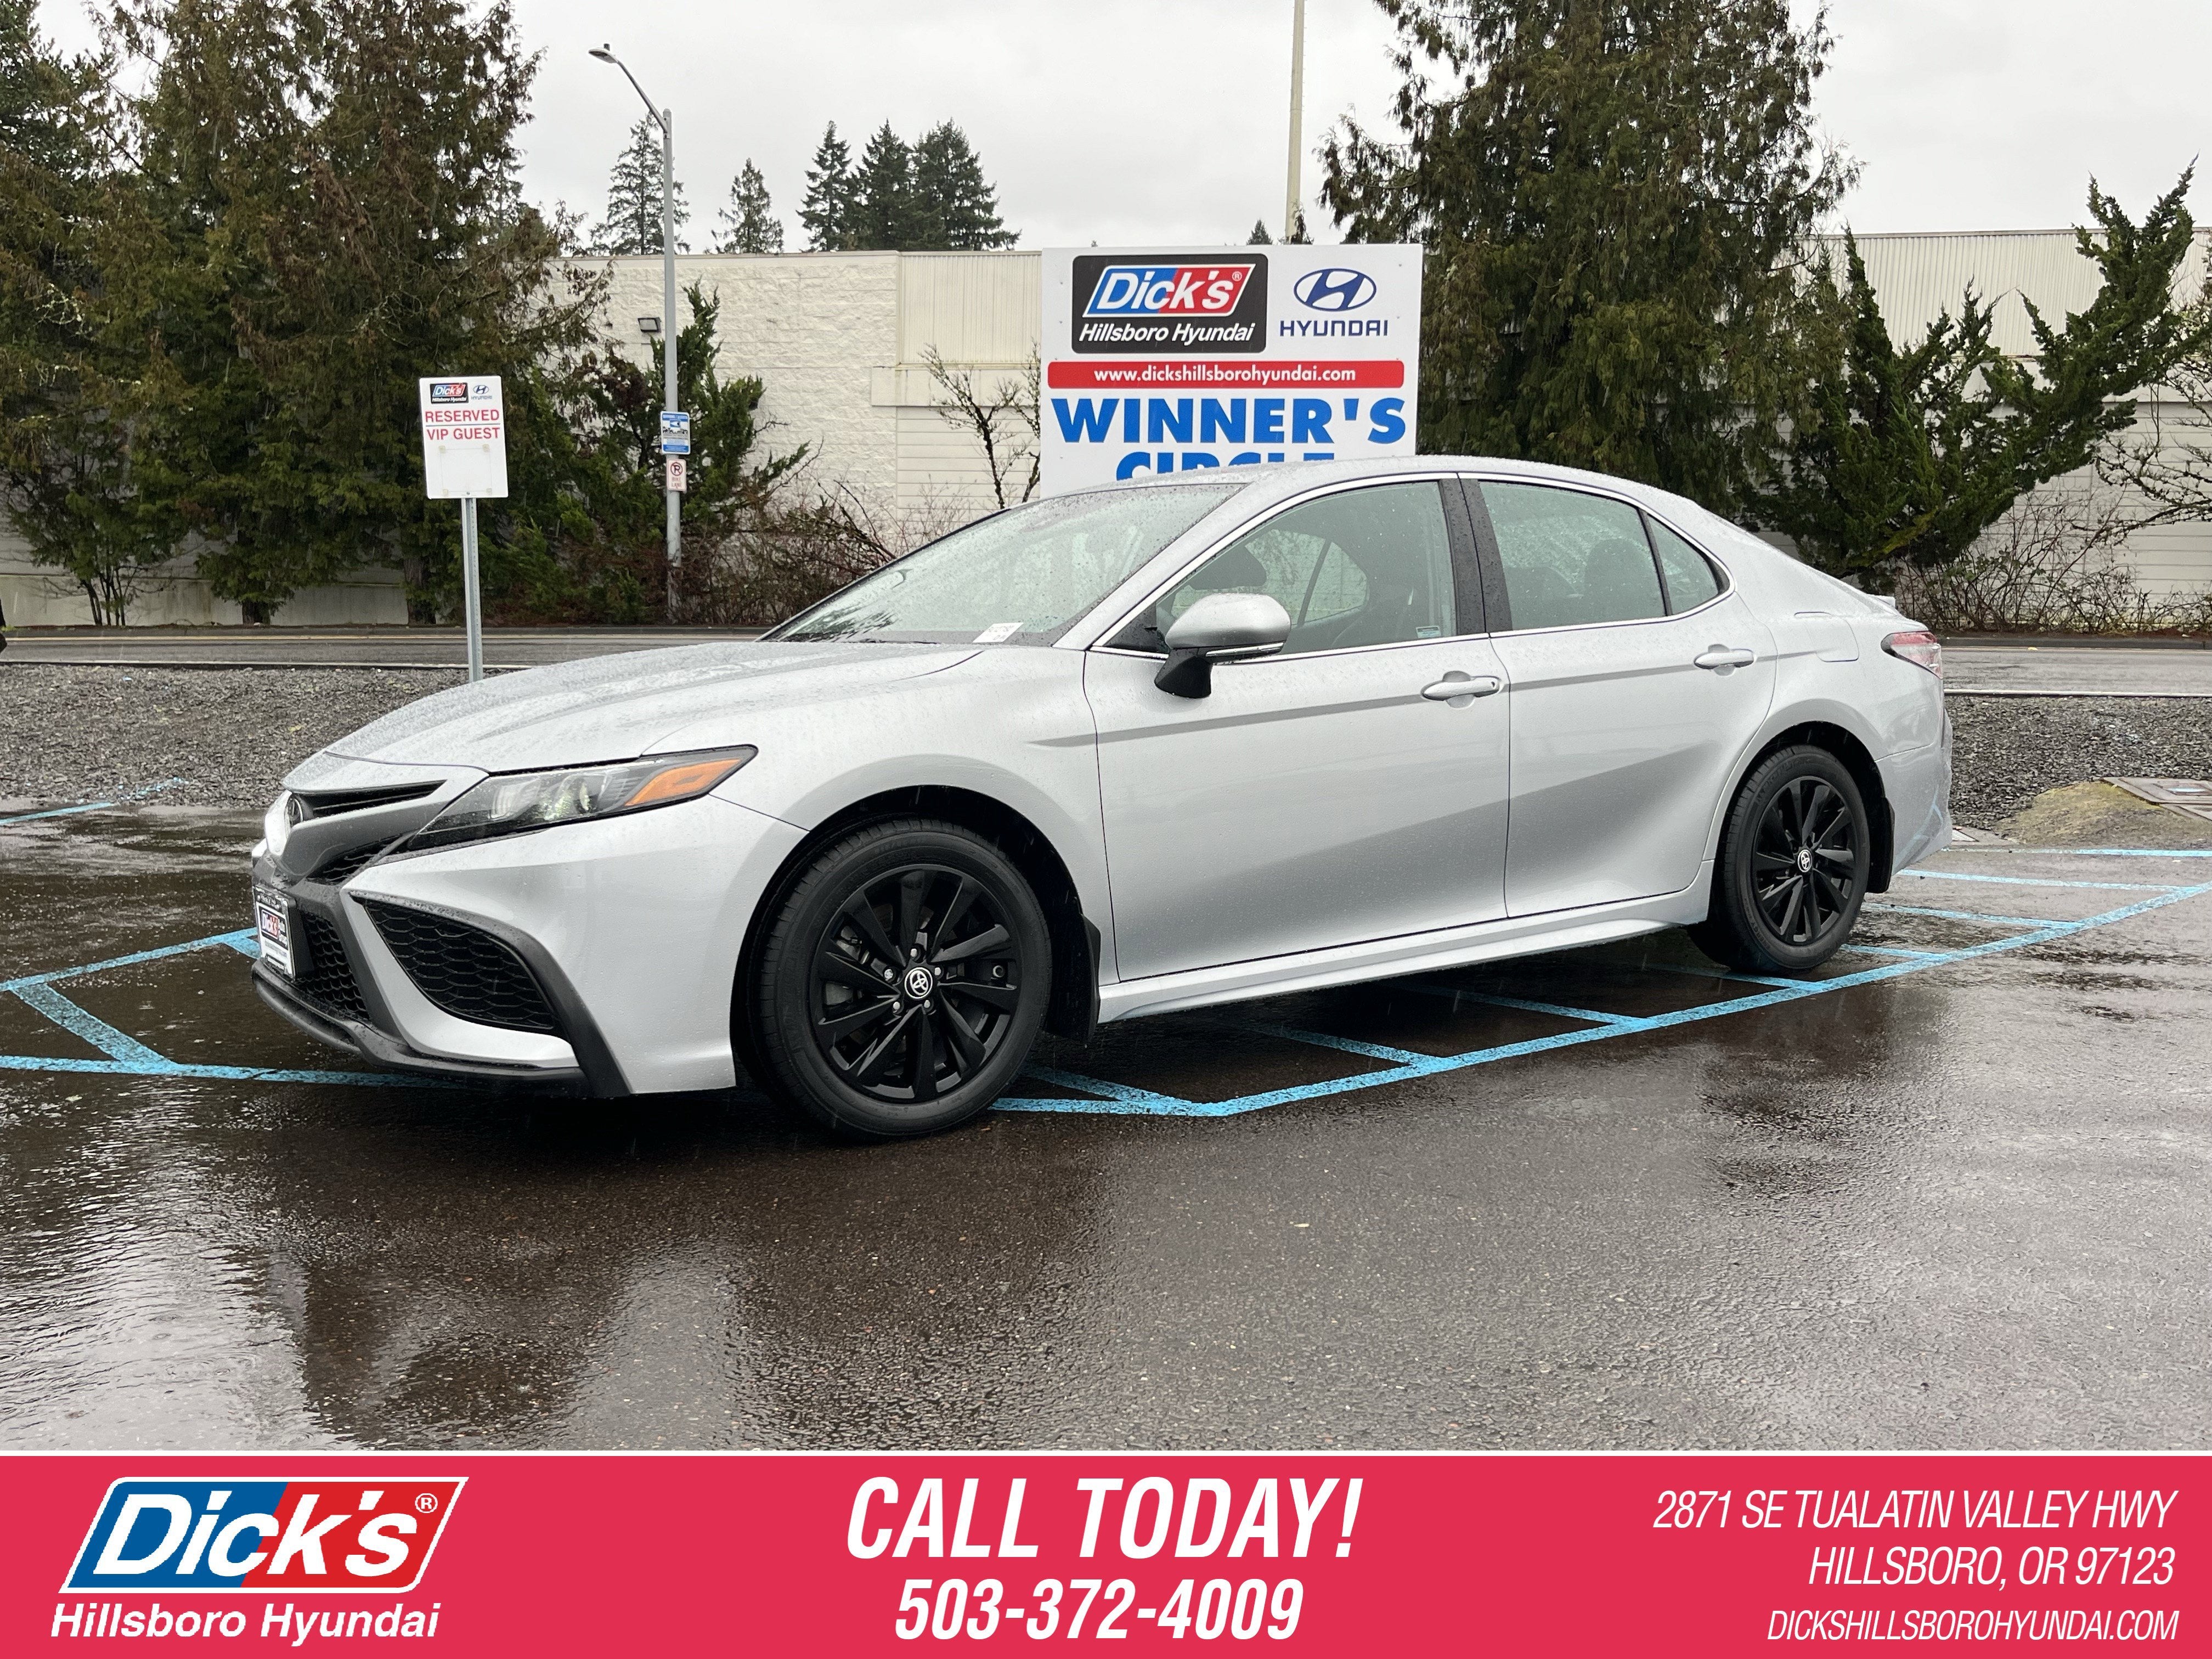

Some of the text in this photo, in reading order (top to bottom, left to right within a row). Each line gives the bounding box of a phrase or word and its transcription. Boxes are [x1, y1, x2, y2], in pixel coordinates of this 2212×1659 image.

[1079, 323, 1256, 346] Hillsboro Hyundai
[1280, 320, 1388, 336] HYUNDAI
[1094, 364, 1356, 385] www.dickshillsborohyundai.com
[425, 409, 500, 422] RESERVED
[1051, 397, 1406, 444] WINNER'S
[427, 427, 500, 440] VIP GUEST
